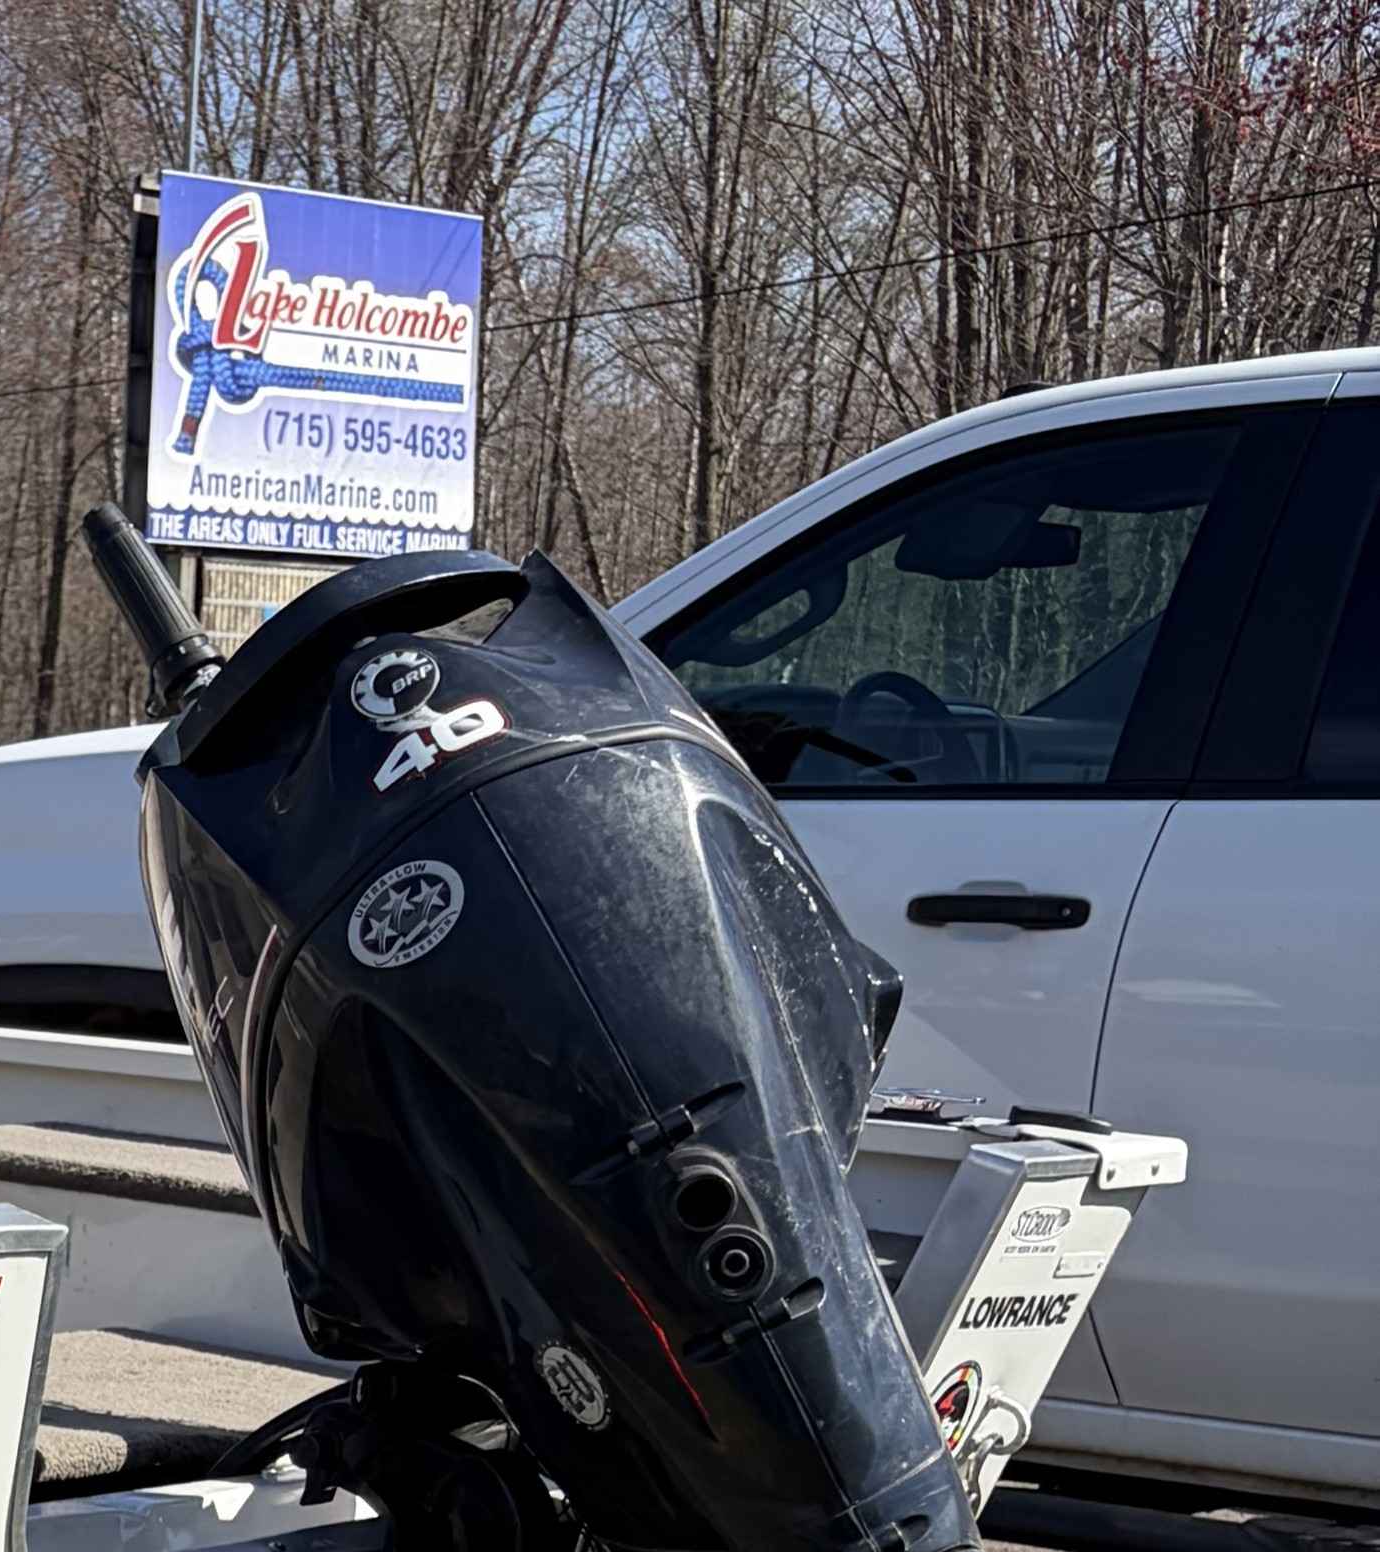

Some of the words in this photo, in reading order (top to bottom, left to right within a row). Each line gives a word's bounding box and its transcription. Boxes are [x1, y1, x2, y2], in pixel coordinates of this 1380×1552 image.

[209, 236, 307, 349] Lake
[312, 286, 468, 345] Holcombe
[322, 343, 420, 373] MARINA
[263, 409, 335, 457] (715)
[344, 417, 467, 461] 595-4633
[189, 464, 439, 515] AmericanMarine.com
[150, 512, 185, 539] THE
[188, 516, 244, 543] AREAS
[247, 518, 291, 547] ONLY
[292, 522, 334, 550] FULL
[337, 525, 404, 555] SERVICE
[392, 664, 433, 694] BRP
[372, 700, 505, 792] 40
[958, 1293, 1080, 1330] LOWRANCE
